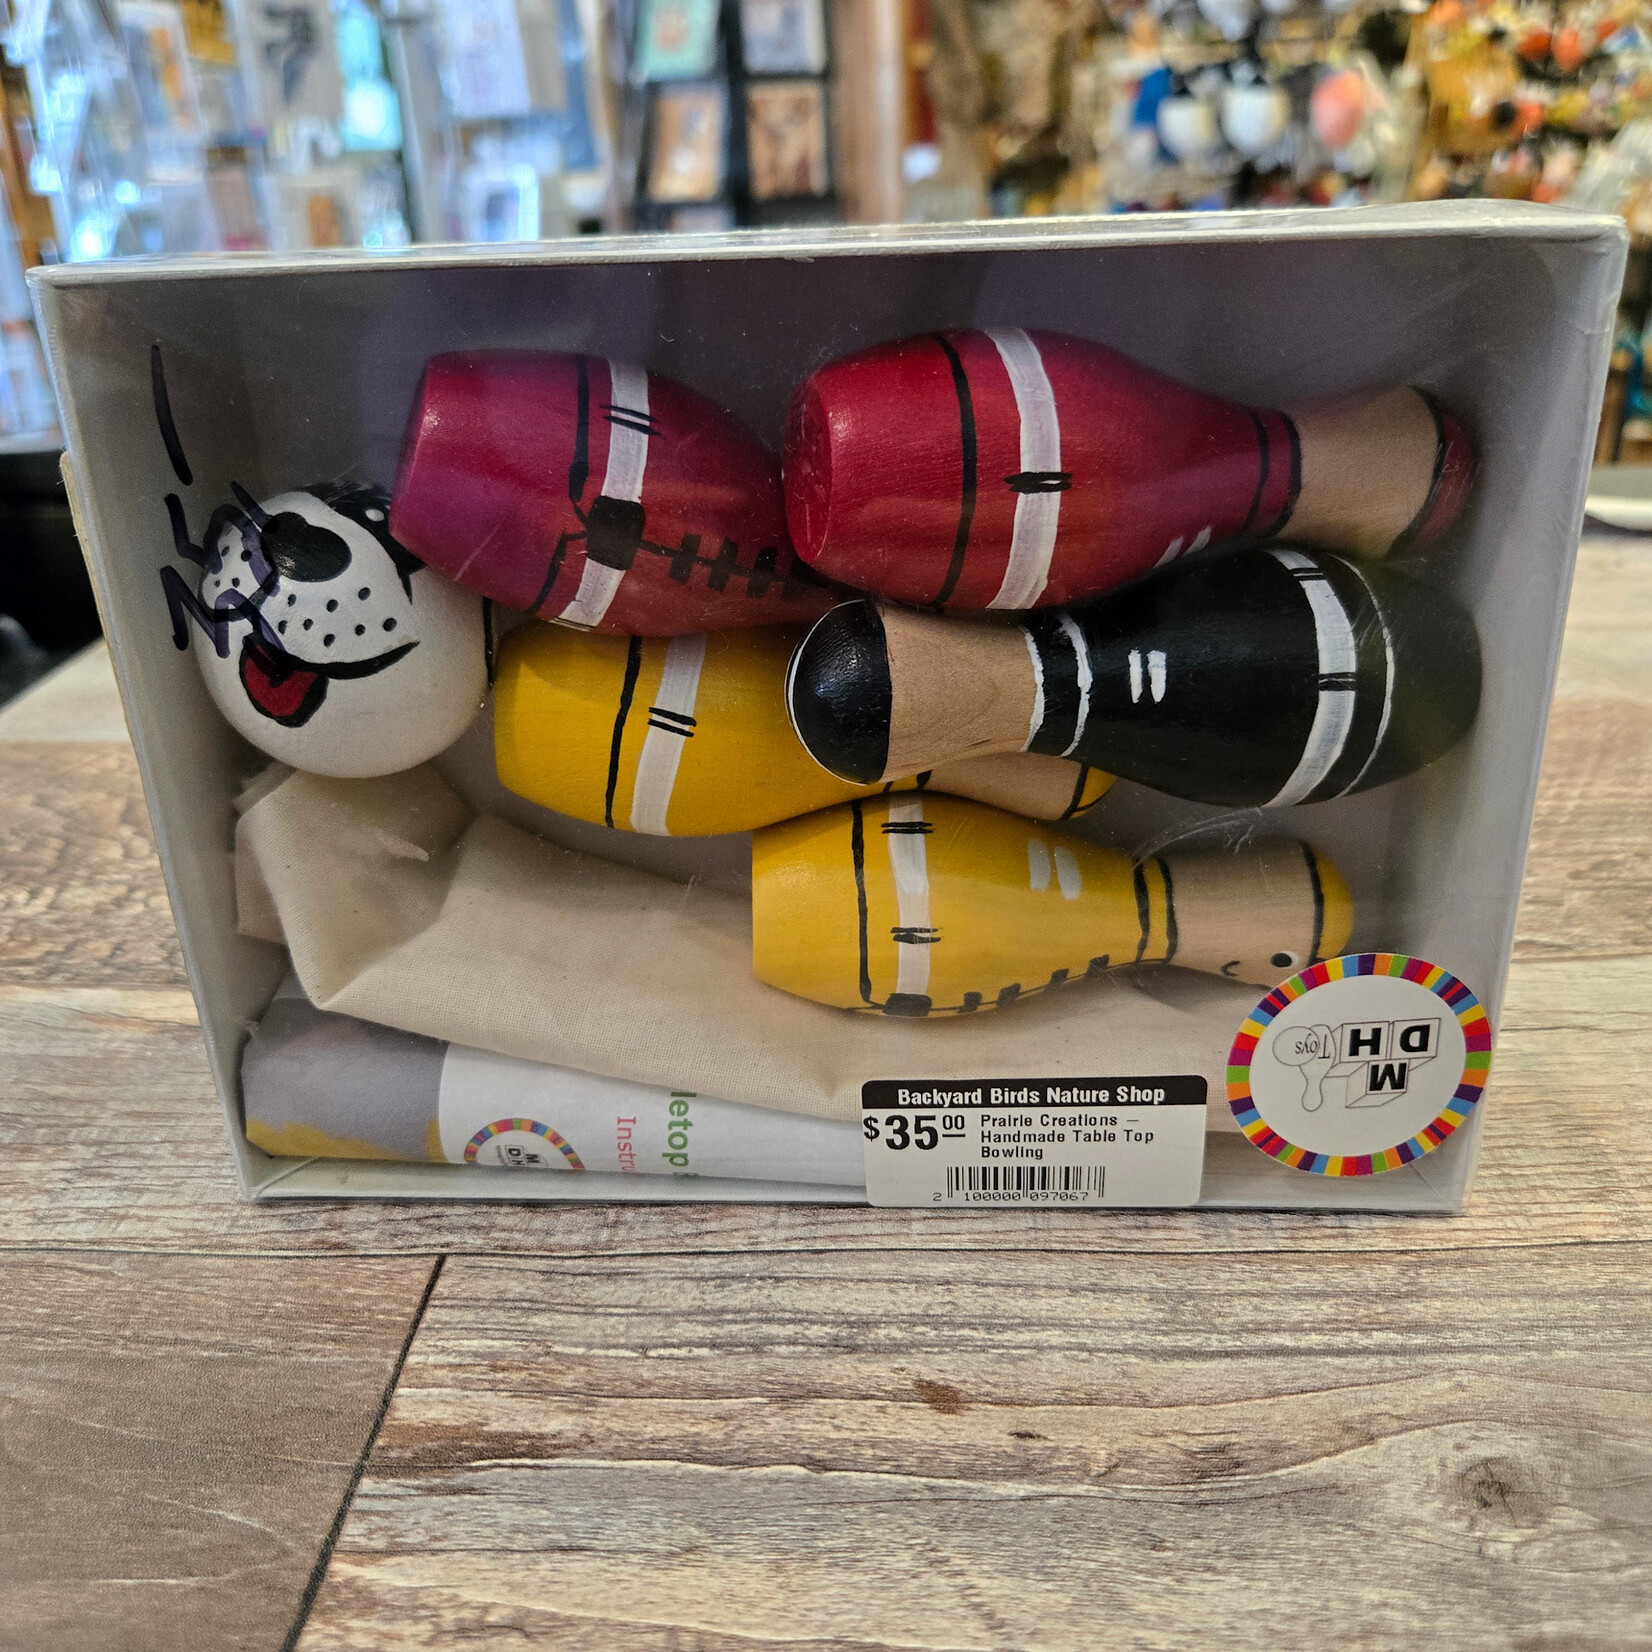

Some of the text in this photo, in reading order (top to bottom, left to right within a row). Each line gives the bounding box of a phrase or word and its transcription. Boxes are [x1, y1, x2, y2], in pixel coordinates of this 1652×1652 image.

[1294, 1032, 1331, 1059] Toys
[897, 1085, 1165, 1108] Backyard Birds Nature Shop
[980, 1114, 1033, 1127] Prairie
[1040, 1114, 1118, 1127] Creations
[980, 1129, 1154, 1144] Handmade Table Top
[980, 1146, 1044, 1160] Bowling
[1029, 1191, 1089, 1201] 097067
